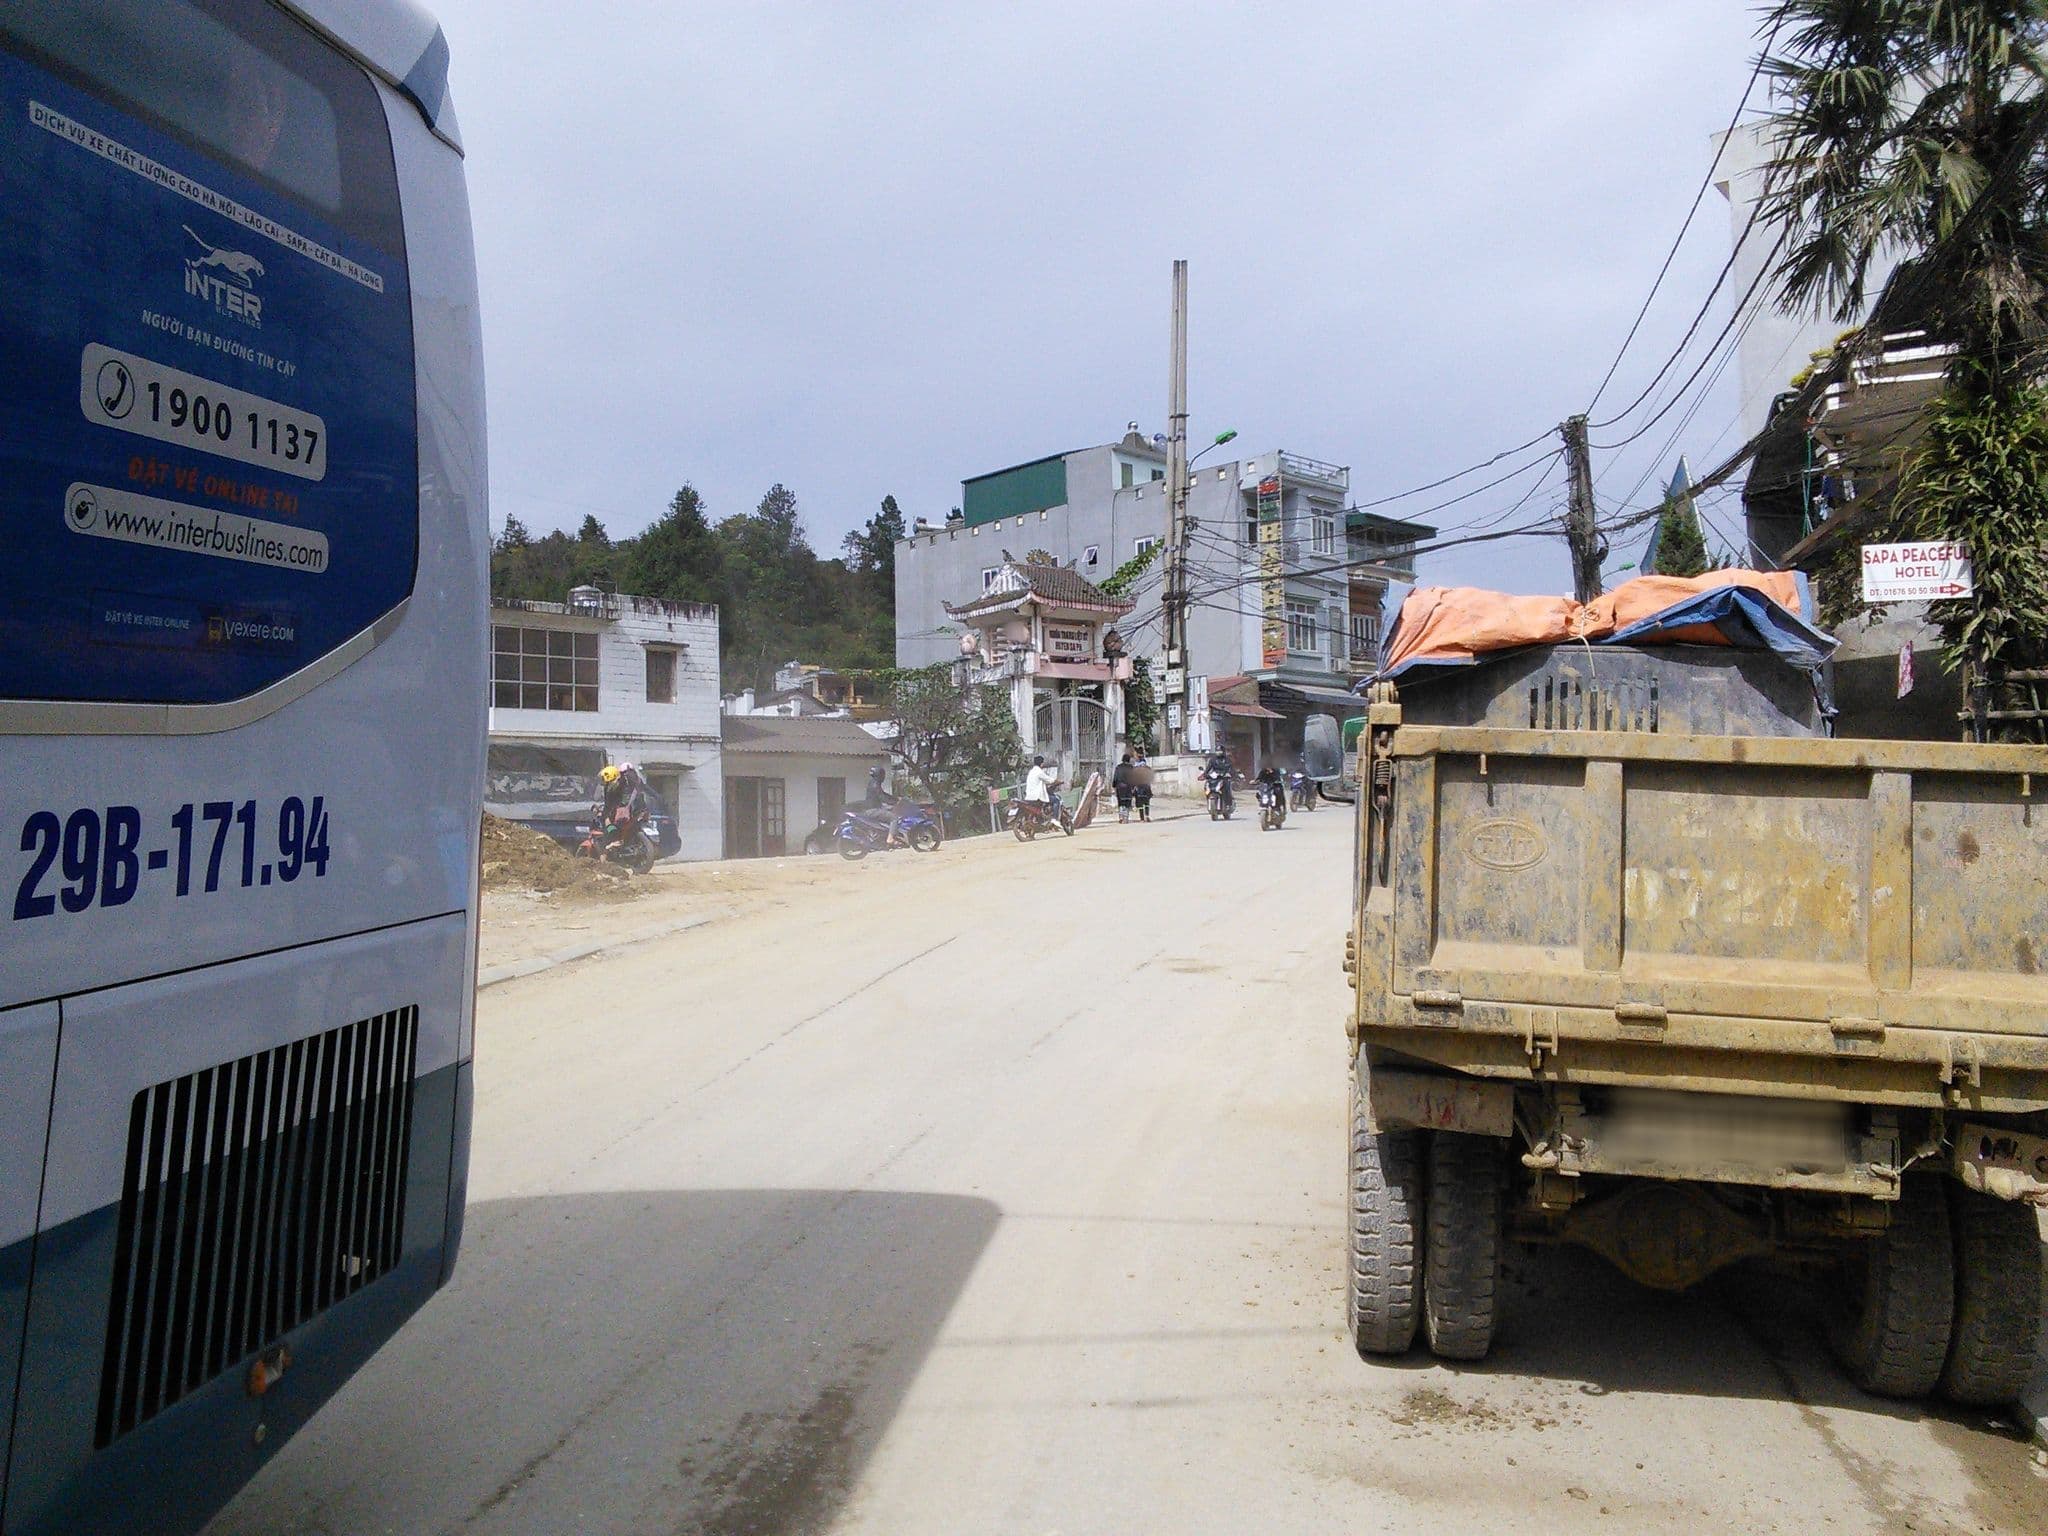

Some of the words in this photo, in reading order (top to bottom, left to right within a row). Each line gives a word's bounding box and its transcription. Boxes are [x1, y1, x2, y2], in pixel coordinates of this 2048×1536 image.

[69, 123, 86, 144] VỤ
[89, 133, 104, 152] XE
[179, 180, 201, 199] CAO
[184, 263, 262, 321] INTER
[142, 309, 183, 337] NGƯỜI
[187, 325, 212, 347] BẠN
[257, 351, 274, 369] TIN
[147, 381, 232, 441] 1900
[247, 412, 318, 465] 1137
[203, 475, 268, 508] ONLINE
[104, 507, 323, 568] www.interbuslines.com
[1864, 550, 1898, 565] SAPA
[1902, 546, 1970, 562] PEACEFUL
[1895, 566, 1939, 578] HOTEL
[13, 795, 330, 921] 29B-171.94
